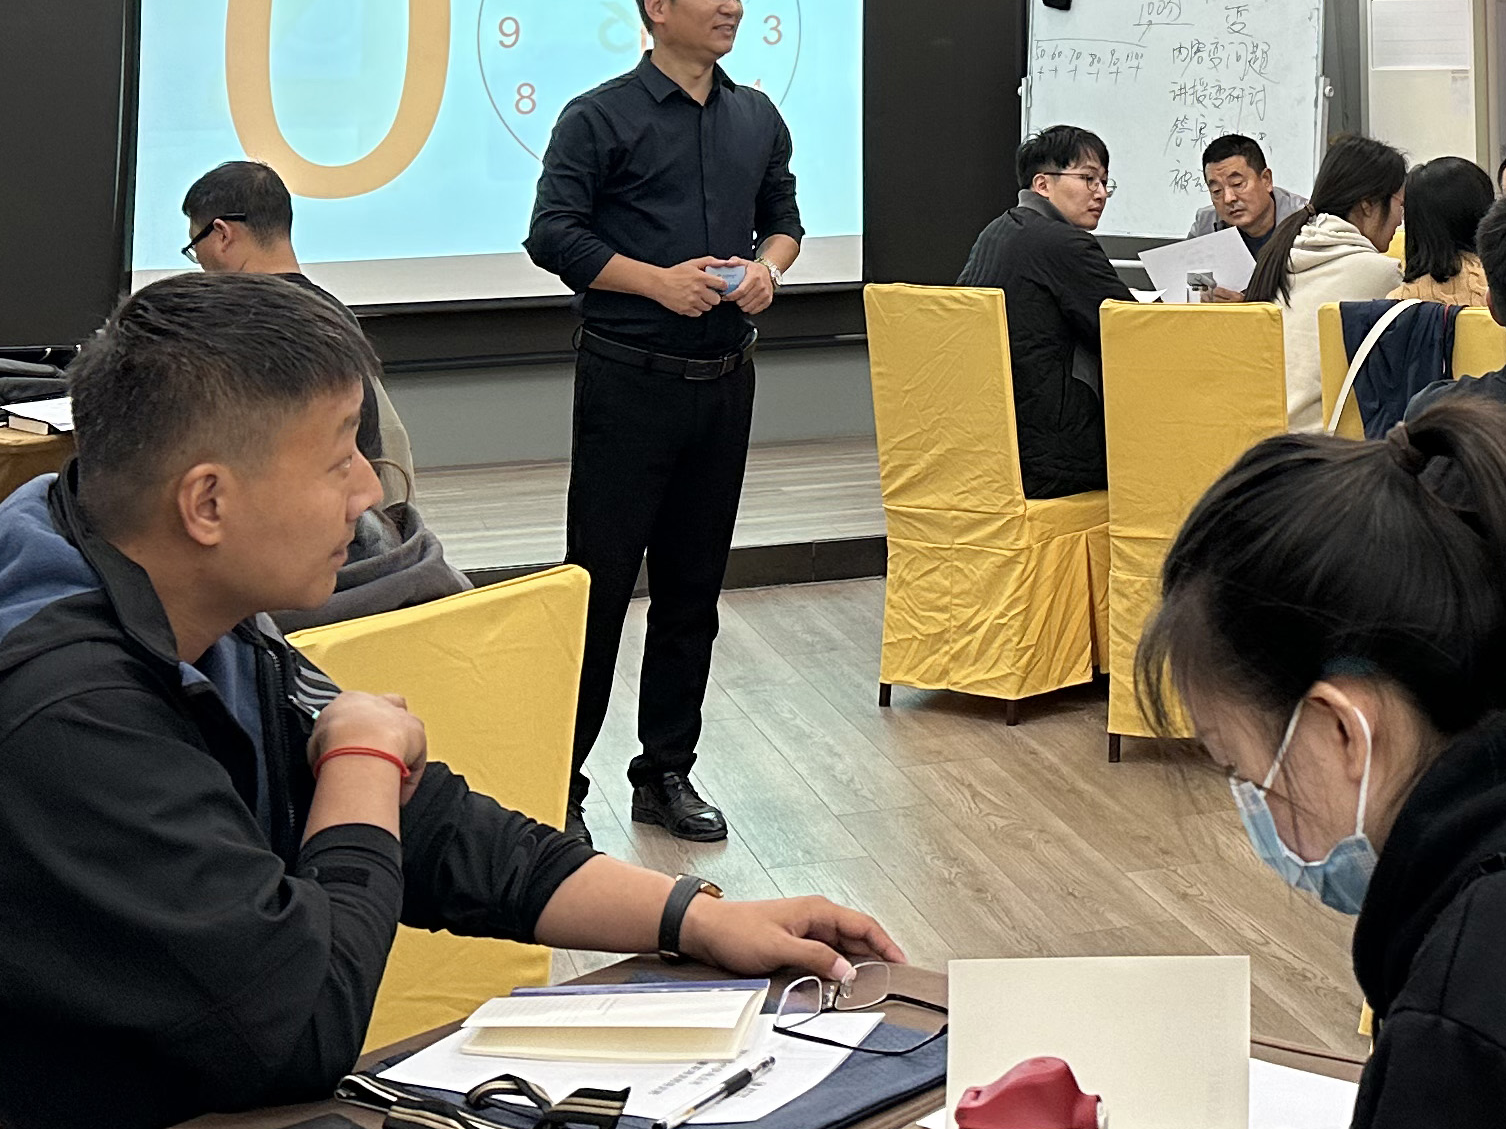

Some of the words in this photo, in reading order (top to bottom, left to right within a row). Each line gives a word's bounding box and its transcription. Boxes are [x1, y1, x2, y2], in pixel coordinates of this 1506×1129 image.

[498, 16, 520, 49] 9
[762, 14, 783, 45] 3
[514, 82, 536, 115] 8
